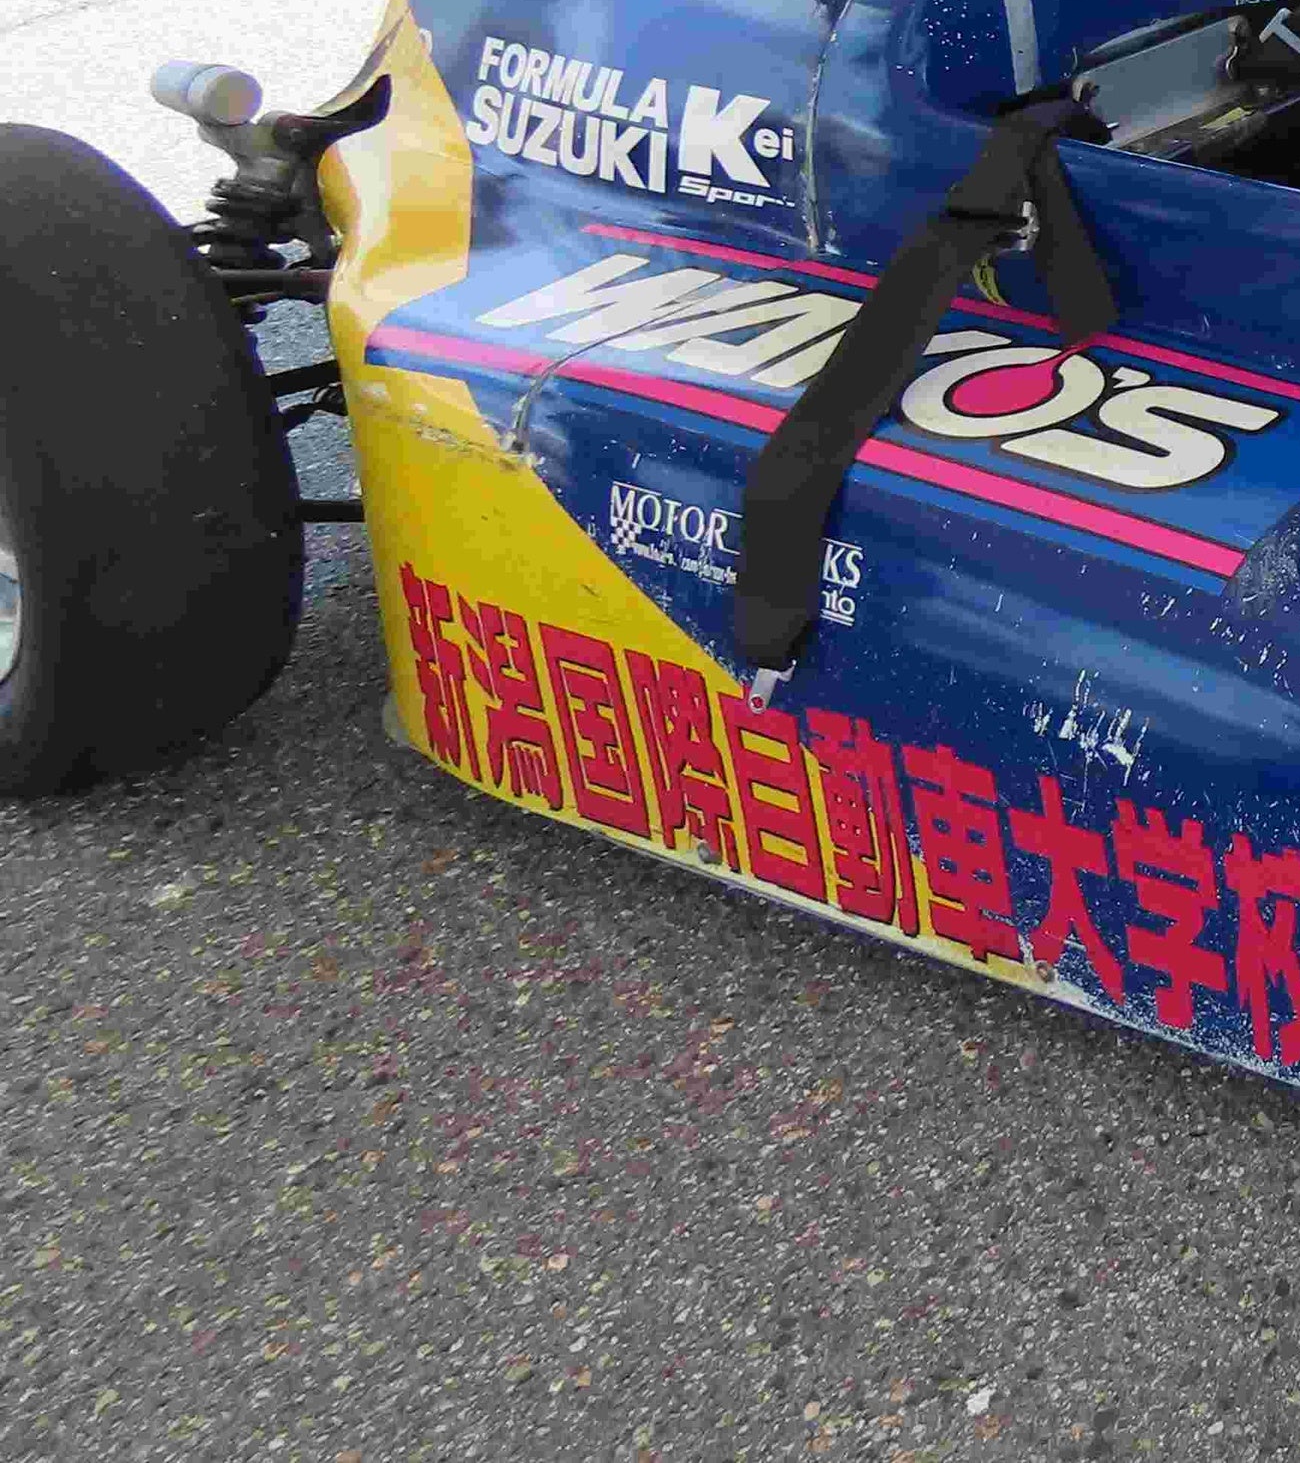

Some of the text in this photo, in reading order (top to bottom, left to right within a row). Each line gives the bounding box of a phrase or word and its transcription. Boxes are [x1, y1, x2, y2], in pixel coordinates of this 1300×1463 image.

[466, 84, 667, 194] SUZUKI
[478, 36, 794, 188] FORMULA Kei
[475, 253, 1281, 490] WAO'S
[610, 483, 738, 555] MOTOR
